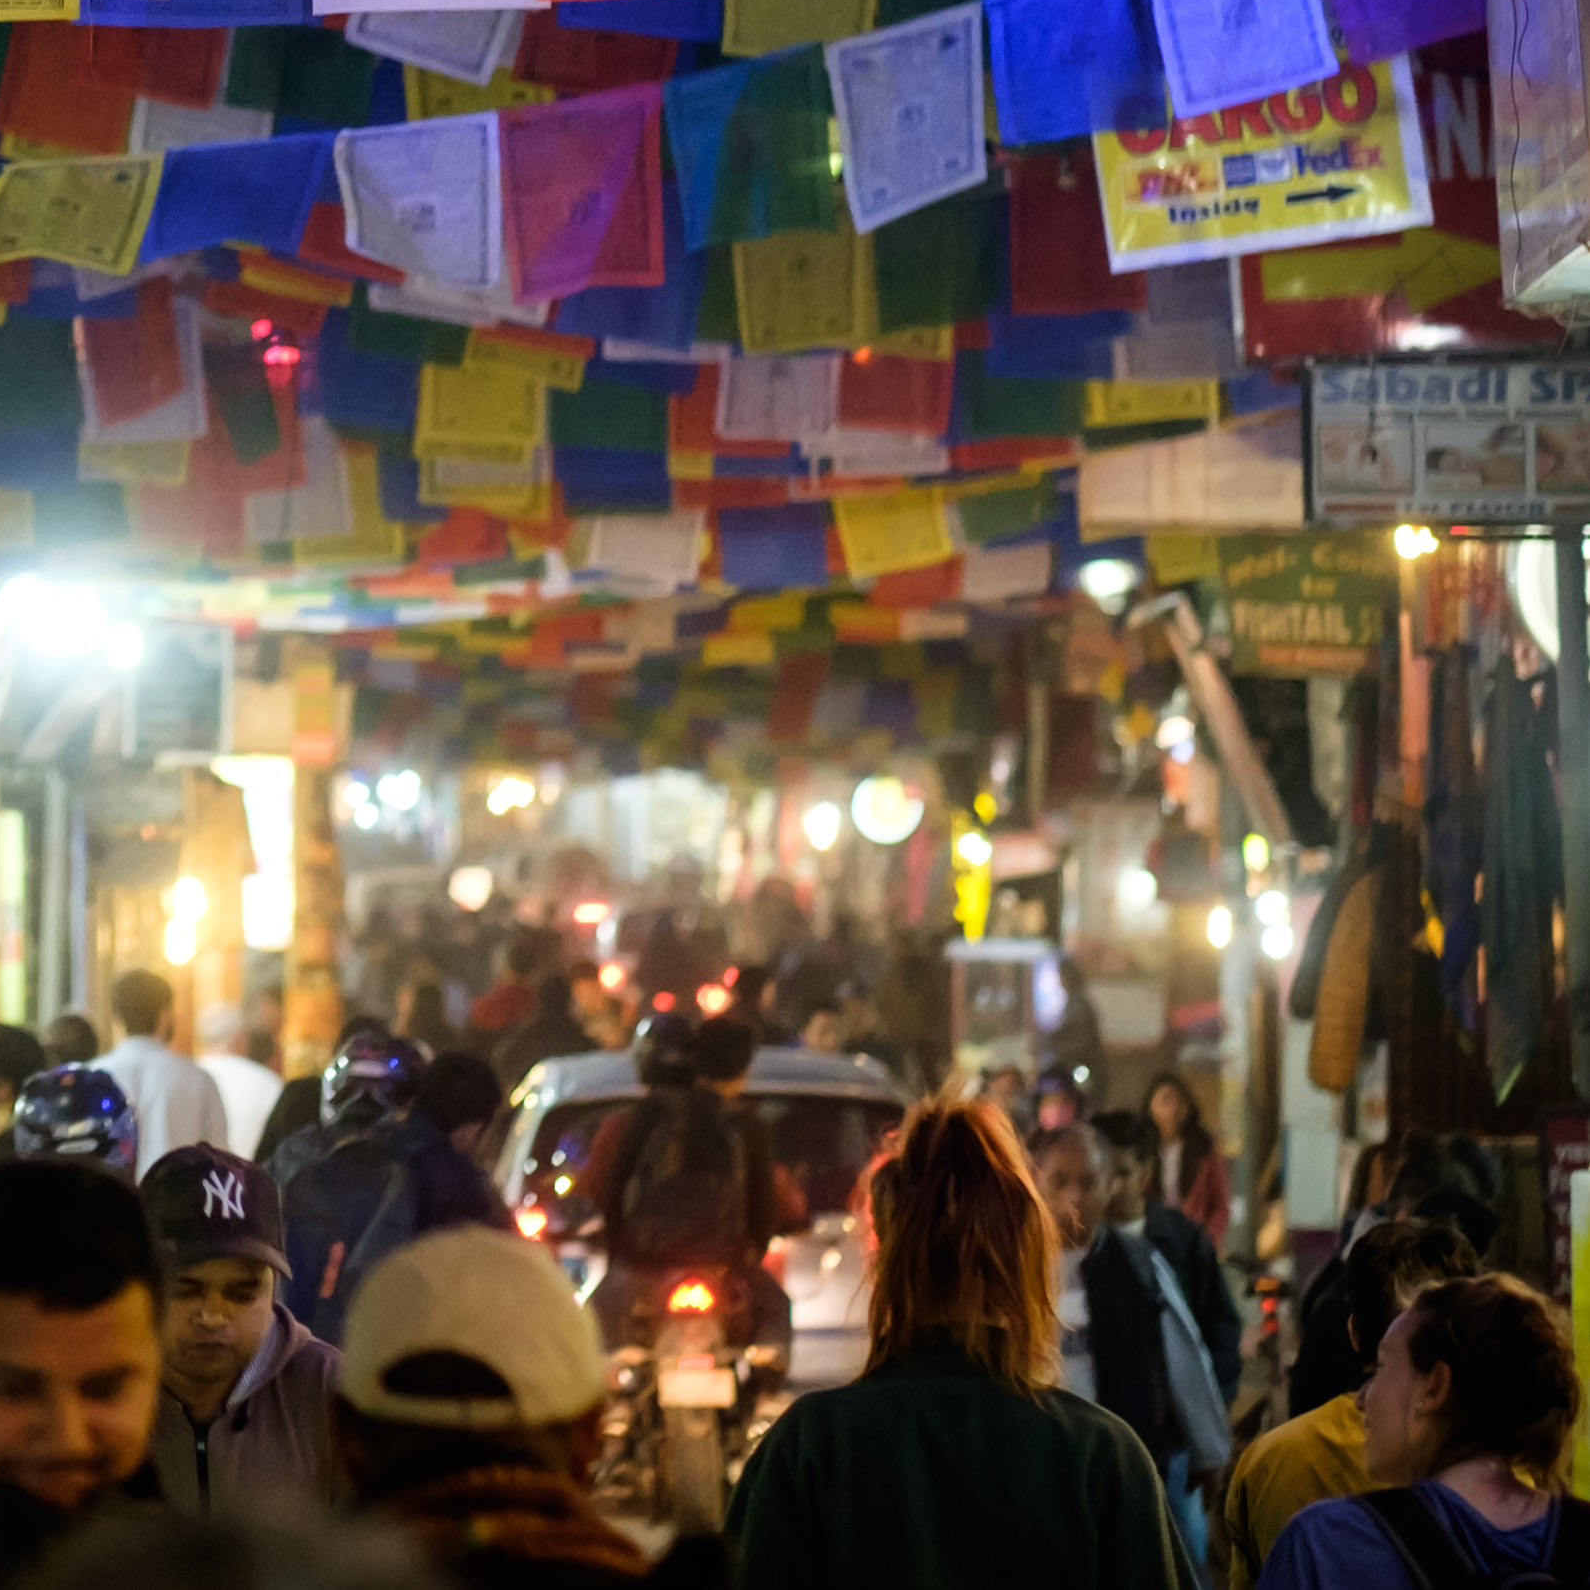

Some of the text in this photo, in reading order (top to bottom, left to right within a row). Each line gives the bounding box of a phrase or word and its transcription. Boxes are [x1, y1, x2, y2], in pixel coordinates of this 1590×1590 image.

[1295, 137, 1384, 177] FedEx
[1321, 366, 1508, 403] Sabadi
[202, 1169, 245, 1220] NY
